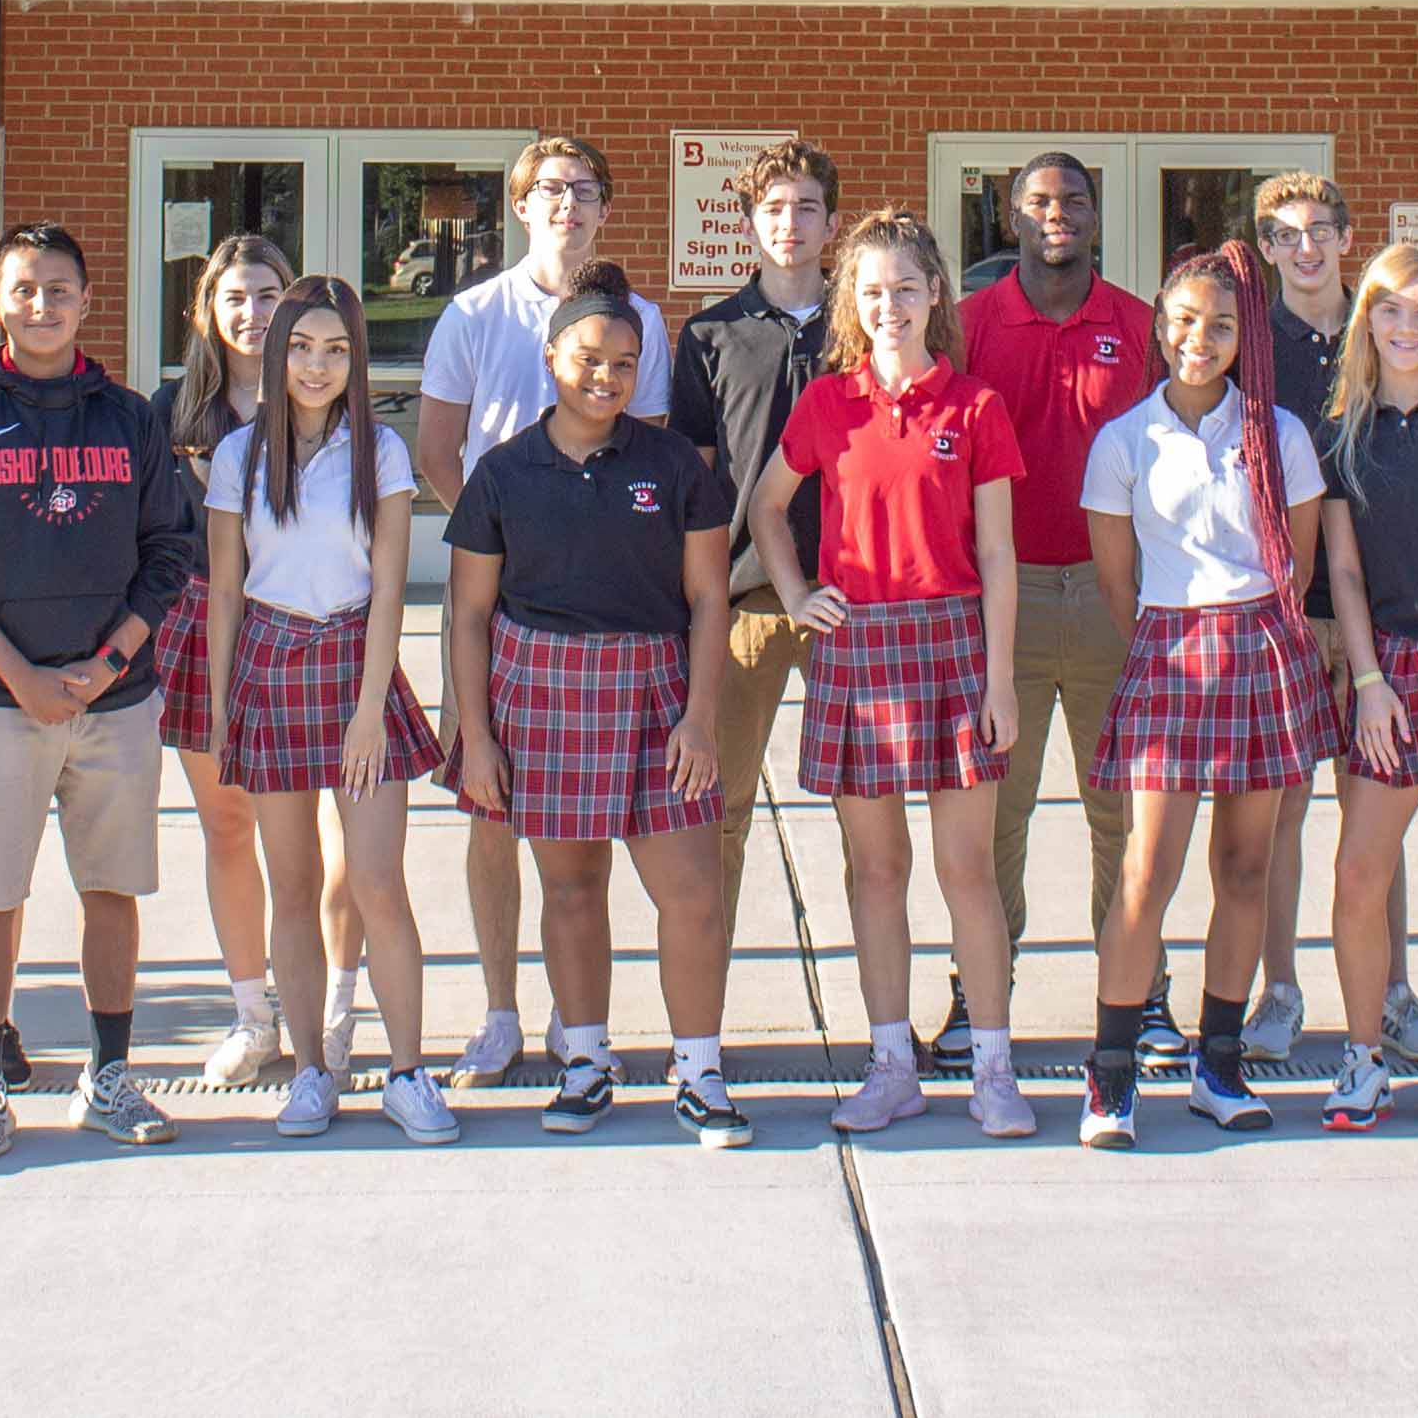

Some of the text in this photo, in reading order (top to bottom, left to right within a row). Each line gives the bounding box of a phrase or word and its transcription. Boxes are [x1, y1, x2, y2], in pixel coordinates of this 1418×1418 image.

[696, 198, 741, 213] Visit
[702, 219, 743, 234] Plea
[687, 240, 753, 259] Sign In
[679, 262, 759, 277] Main Off
